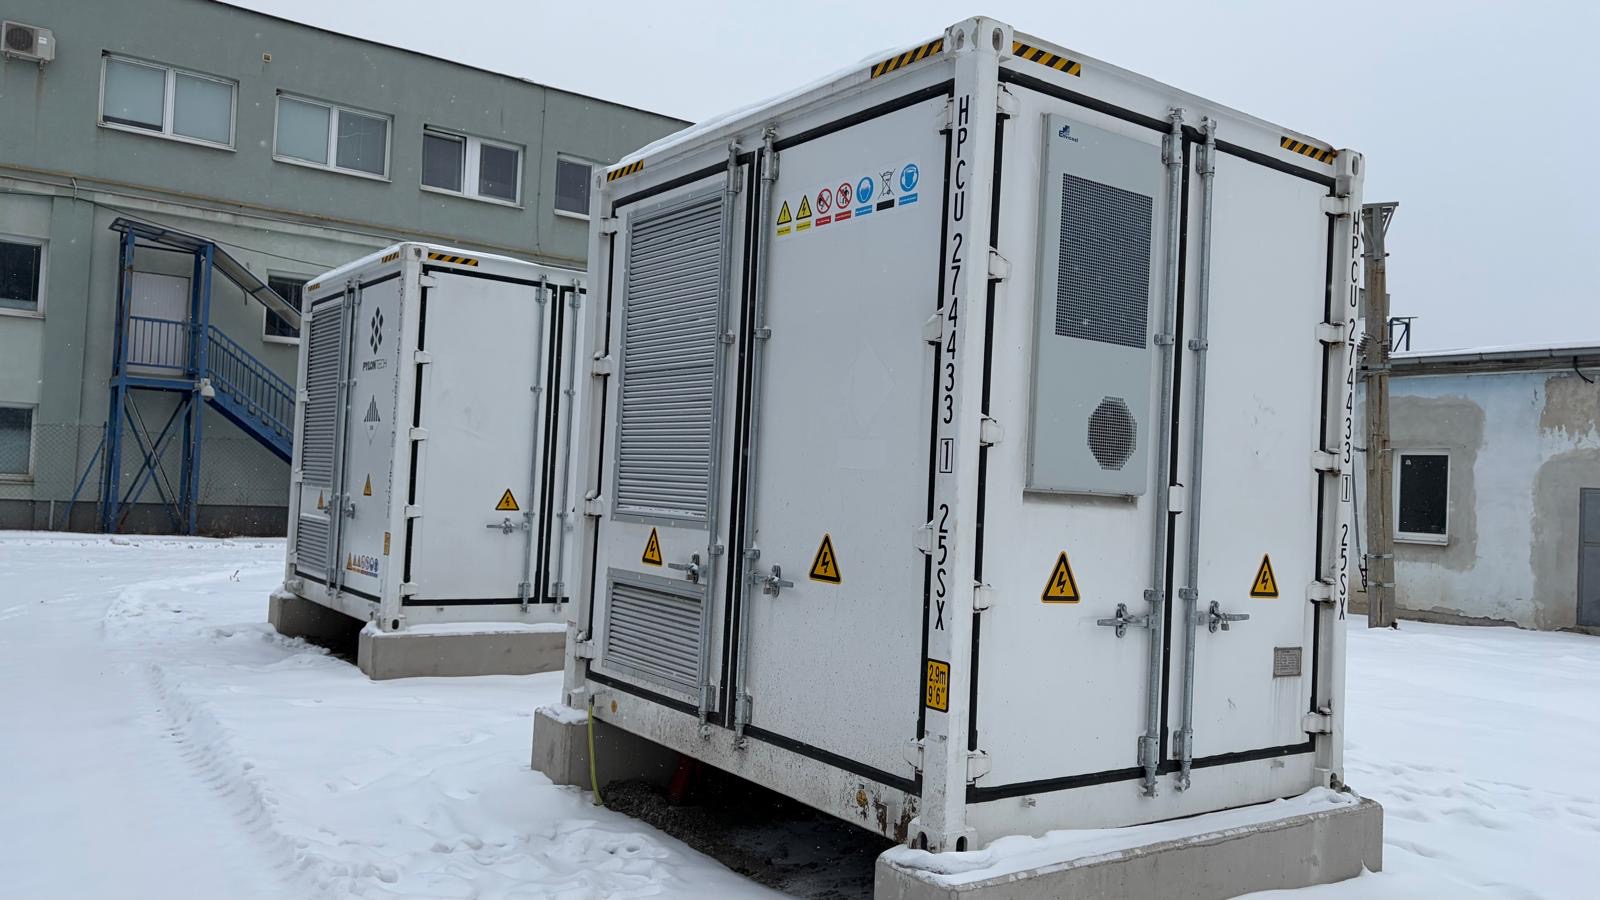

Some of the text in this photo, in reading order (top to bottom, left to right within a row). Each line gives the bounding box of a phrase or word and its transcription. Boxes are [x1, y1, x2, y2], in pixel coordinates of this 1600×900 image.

[953, 94, 970, 222] HPCU
[1350, 211, 1360, 308] HPCU
[943, 233, 962, 424] 274433
[1344, 318, 1356, 464] 274433
[935, 503, 949, 631] 25SX
[1339, 523, 1348, 620] 25SX
